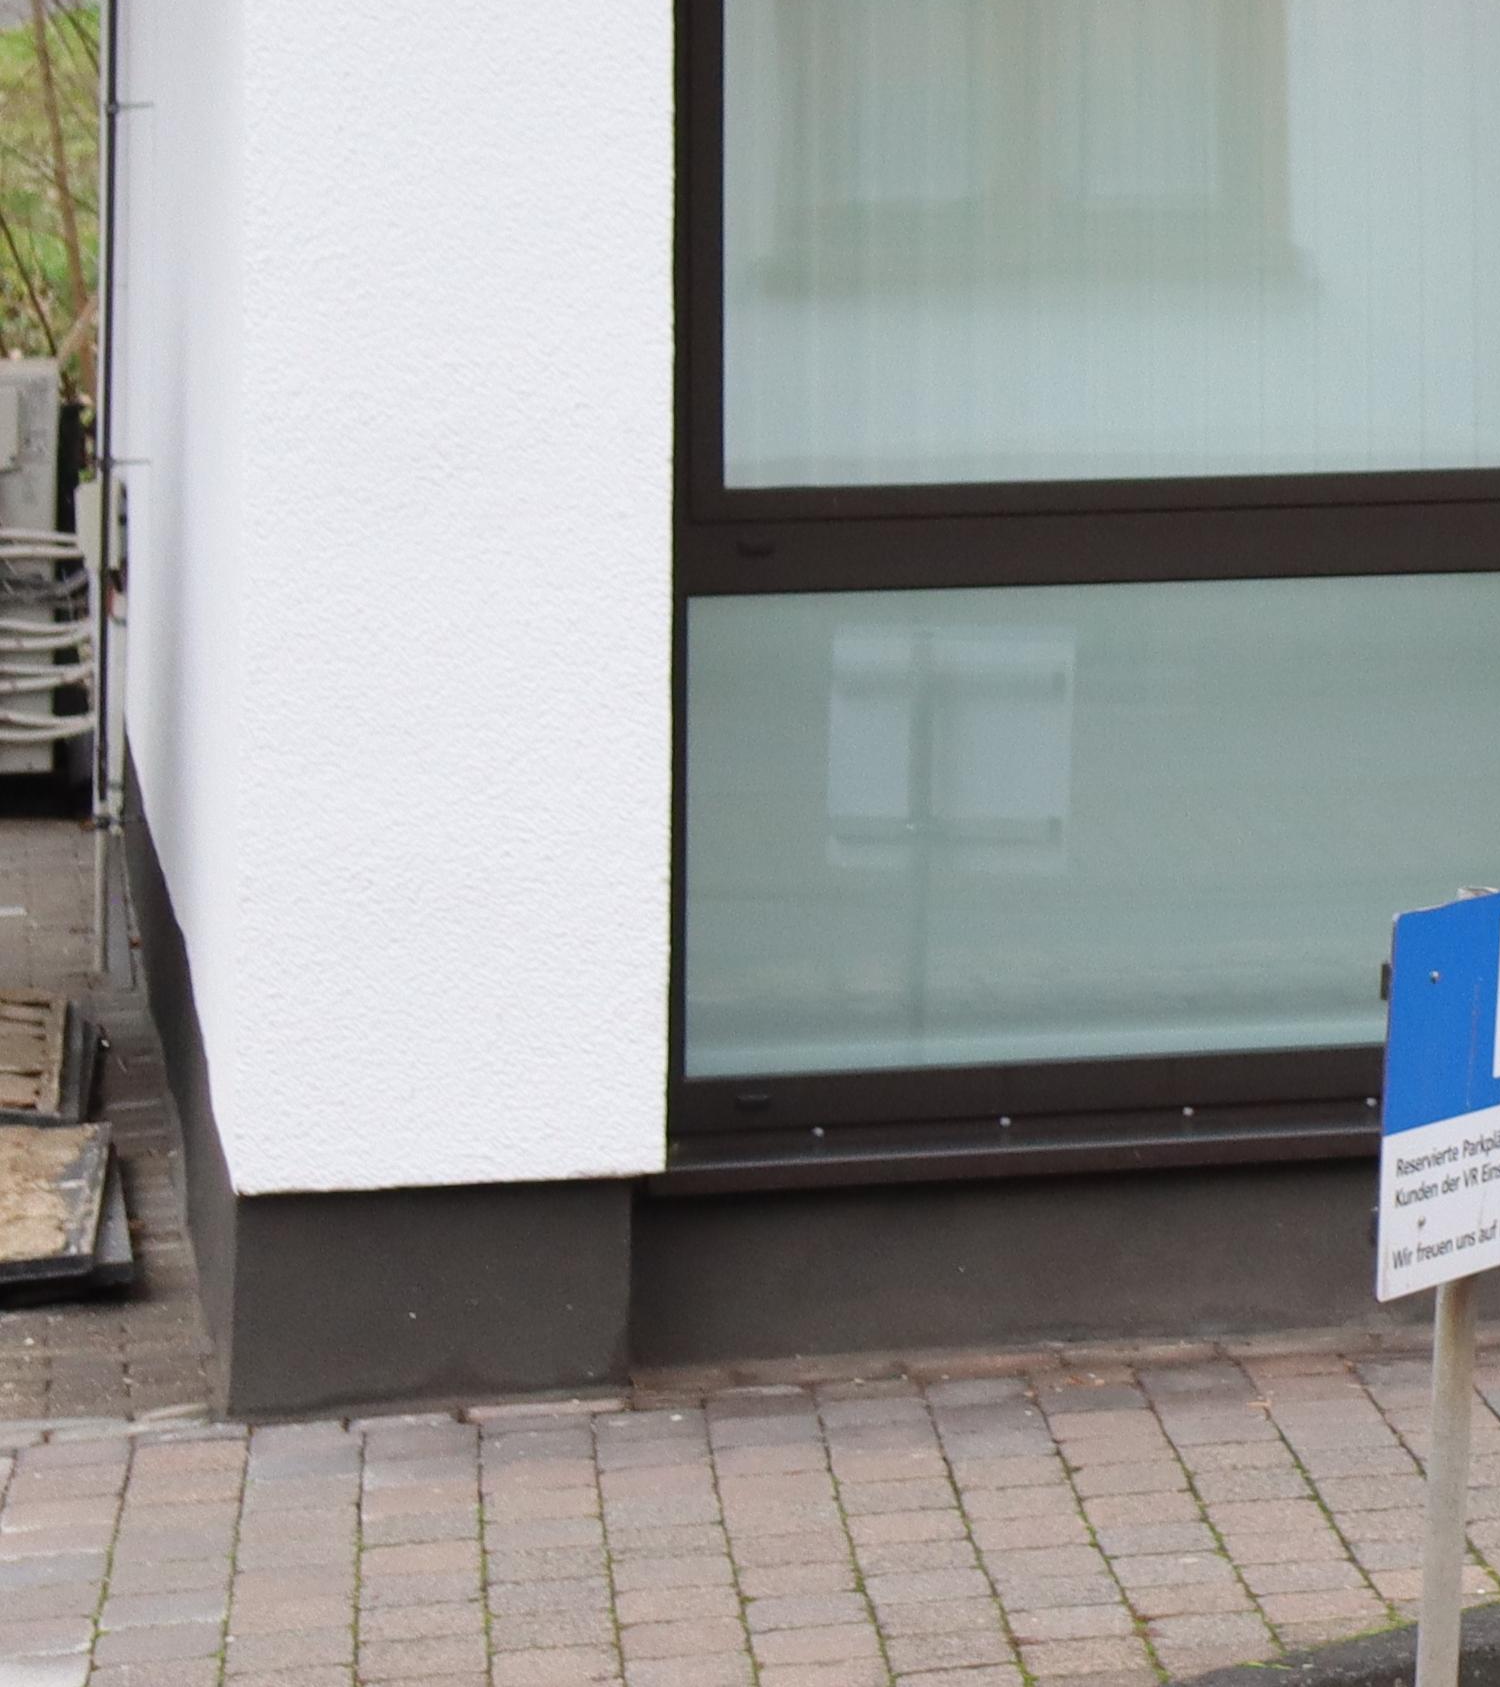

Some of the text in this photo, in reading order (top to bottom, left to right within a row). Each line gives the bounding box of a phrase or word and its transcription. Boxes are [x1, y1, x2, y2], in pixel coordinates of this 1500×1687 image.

[1396, 1146, 1459, 1177] Reservierte
[1395, 1181, 1439, 1208] Kunden
[1441, 1174, 1460, 1195] der
[1463, 1167, 1479, 1188] VR
[1392, 1246, 1413, 1269] Wir
[1416, 1238, 1453, 1262] freuen
[1456, 1231, 1476, 1250] uns
[1478, 1219, 1497, 1243] auf
